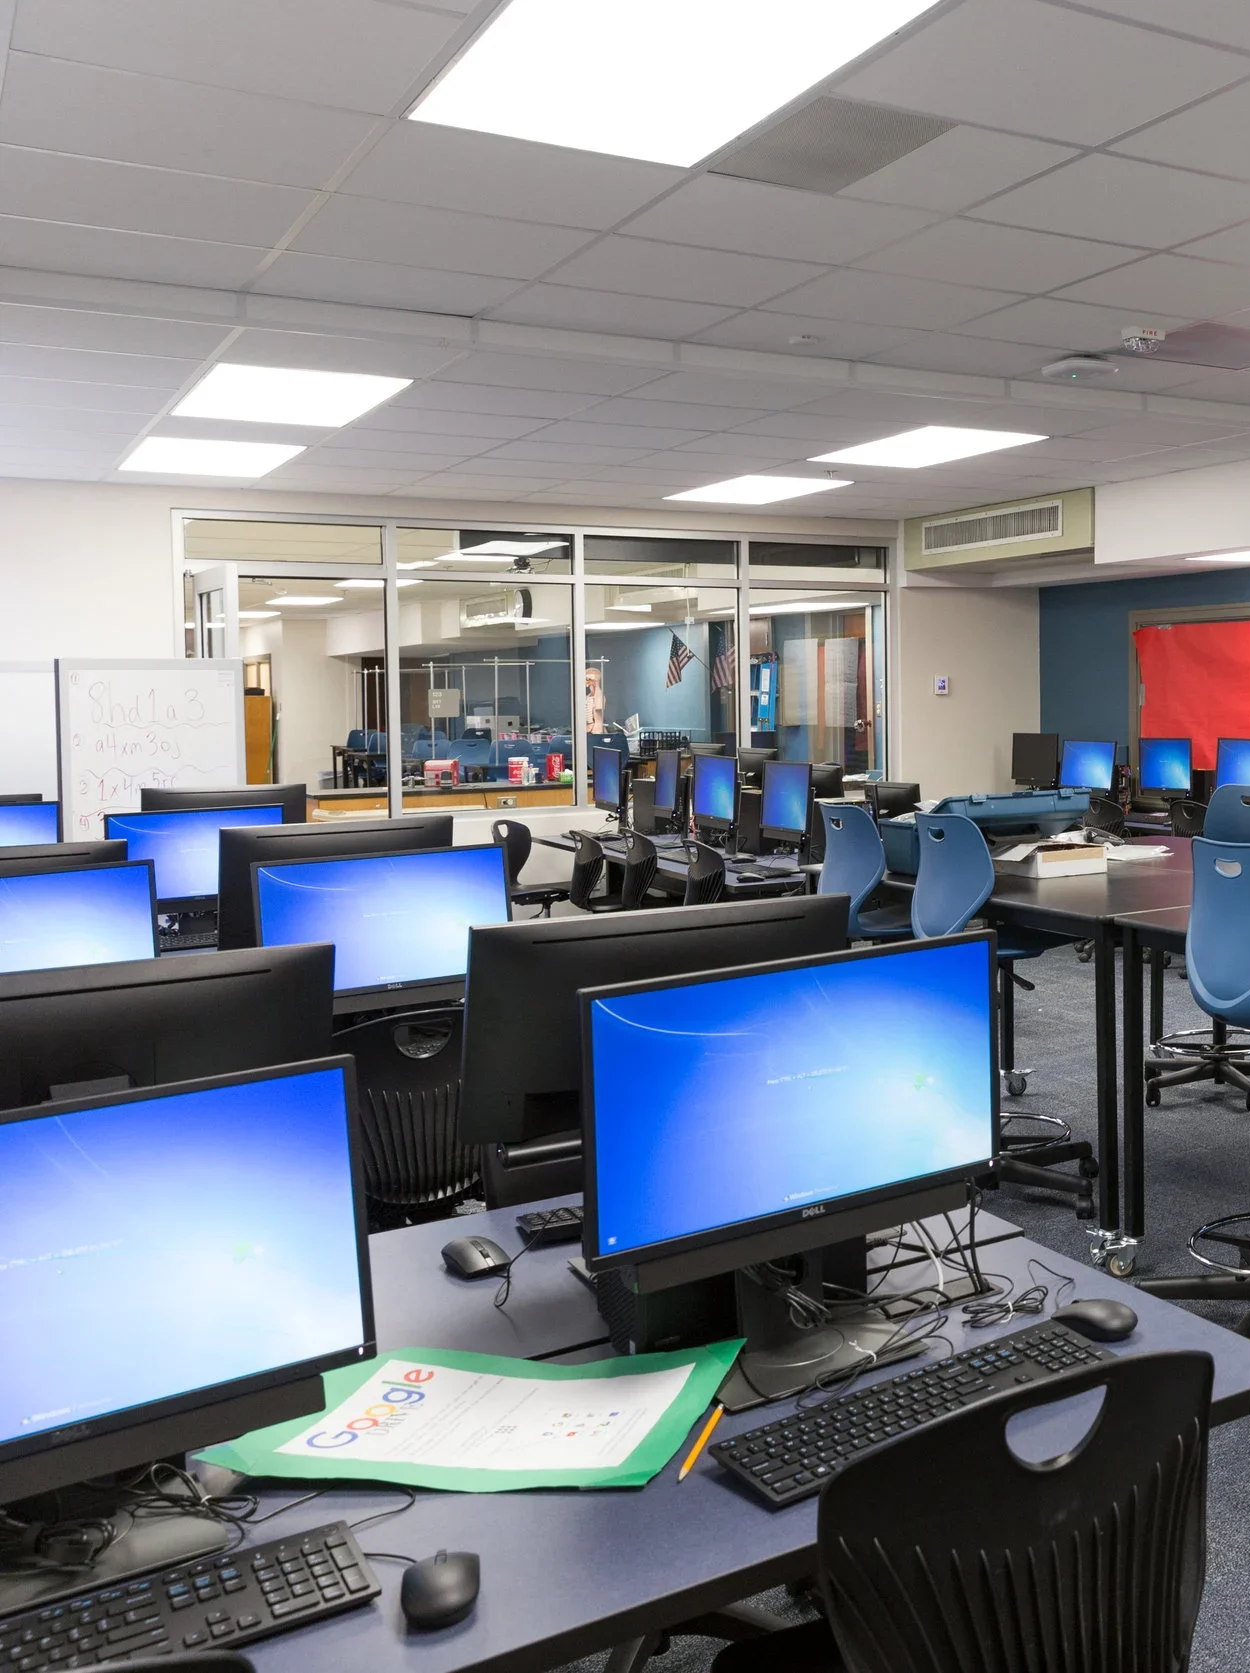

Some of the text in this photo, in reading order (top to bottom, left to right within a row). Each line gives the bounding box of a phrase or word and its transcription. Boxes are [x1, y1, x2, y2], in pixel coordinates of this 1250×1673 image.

[1142, 329, 1158, 337] FIRE
[801, 1204, 827, 1218] DELL
[306, 1367, 435, 1449] Google
